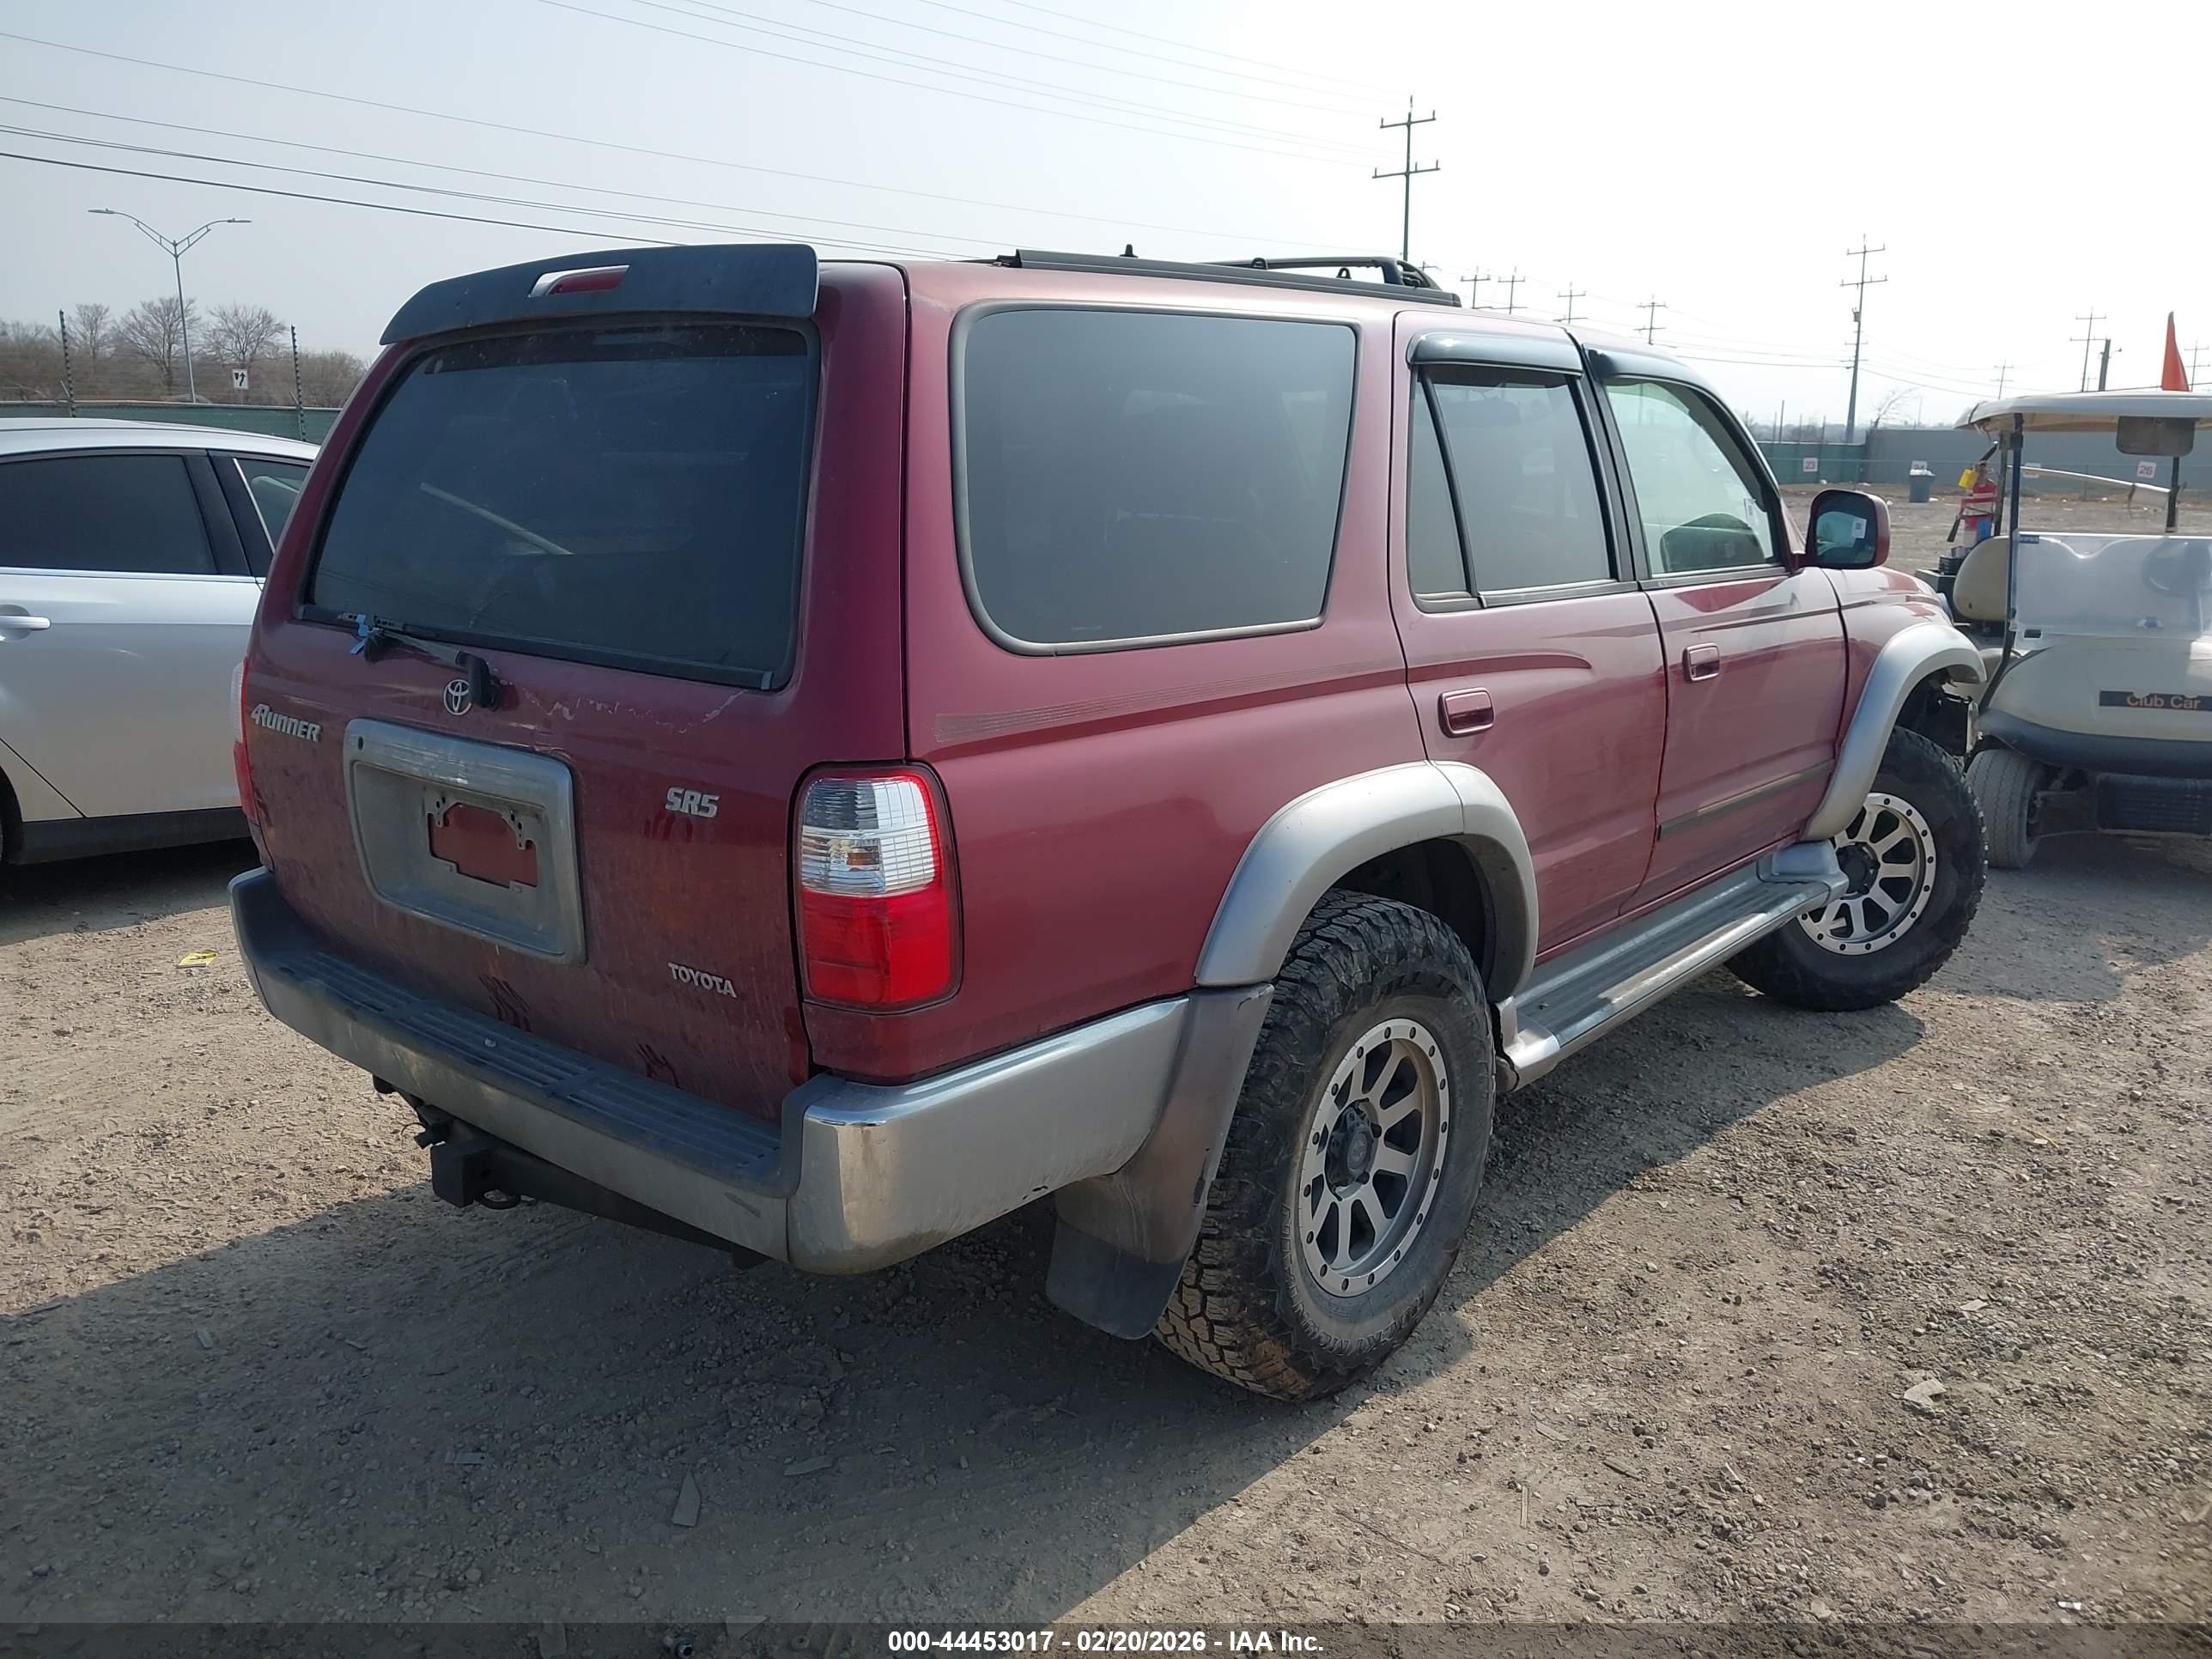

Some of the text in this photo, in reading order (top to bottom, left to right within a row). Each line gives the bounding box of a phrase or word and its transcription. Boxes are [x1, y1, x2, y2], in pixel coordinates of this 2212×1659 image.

[2139, 465, 2154, 476] 26
[2126, 694, 2201, 709] Club Car
[665, 787, 720, 817] SR5
[667, 962, 738, 998] TOYOTA
